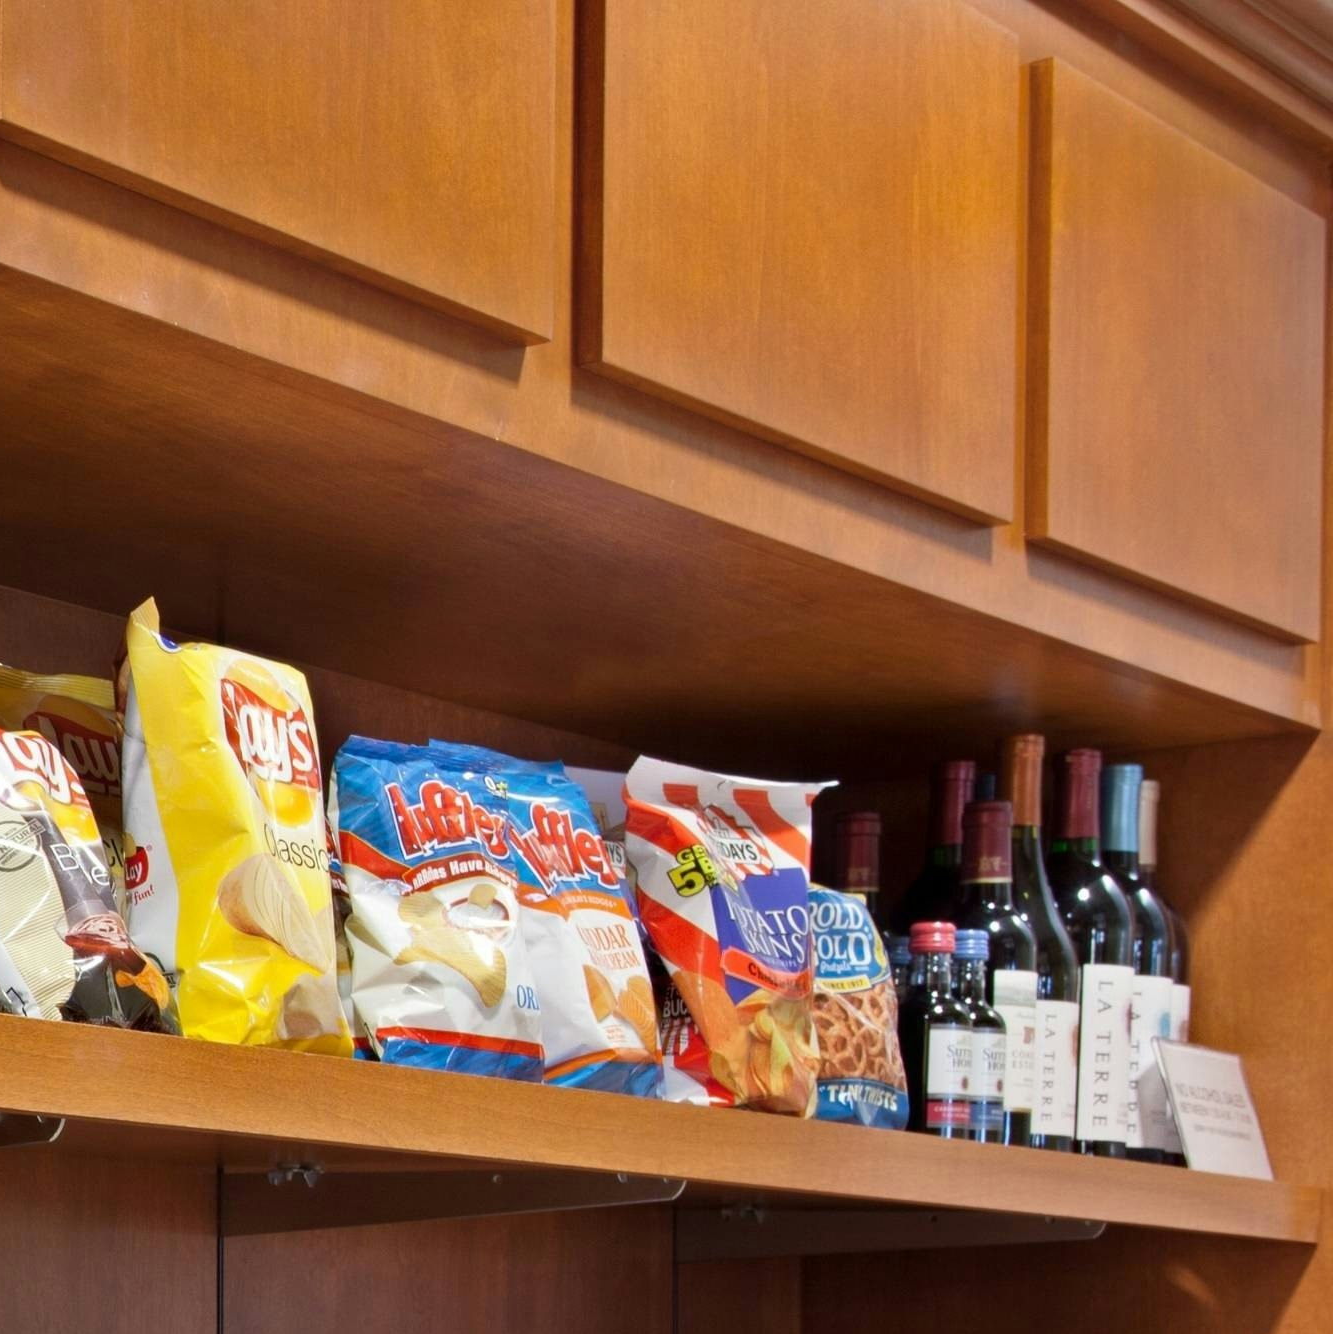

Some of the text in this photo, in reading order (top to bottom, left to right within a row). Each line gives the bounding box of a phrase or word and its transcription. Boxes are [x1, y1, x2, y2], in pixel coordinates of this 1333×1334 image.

[449, 856, 484, 877] Have
[667, 860, 707, 898] 5
[1040, 1013, 1059, 1122] LA TERRE
[1091, 979, 1115, 1128] LA TERRE
